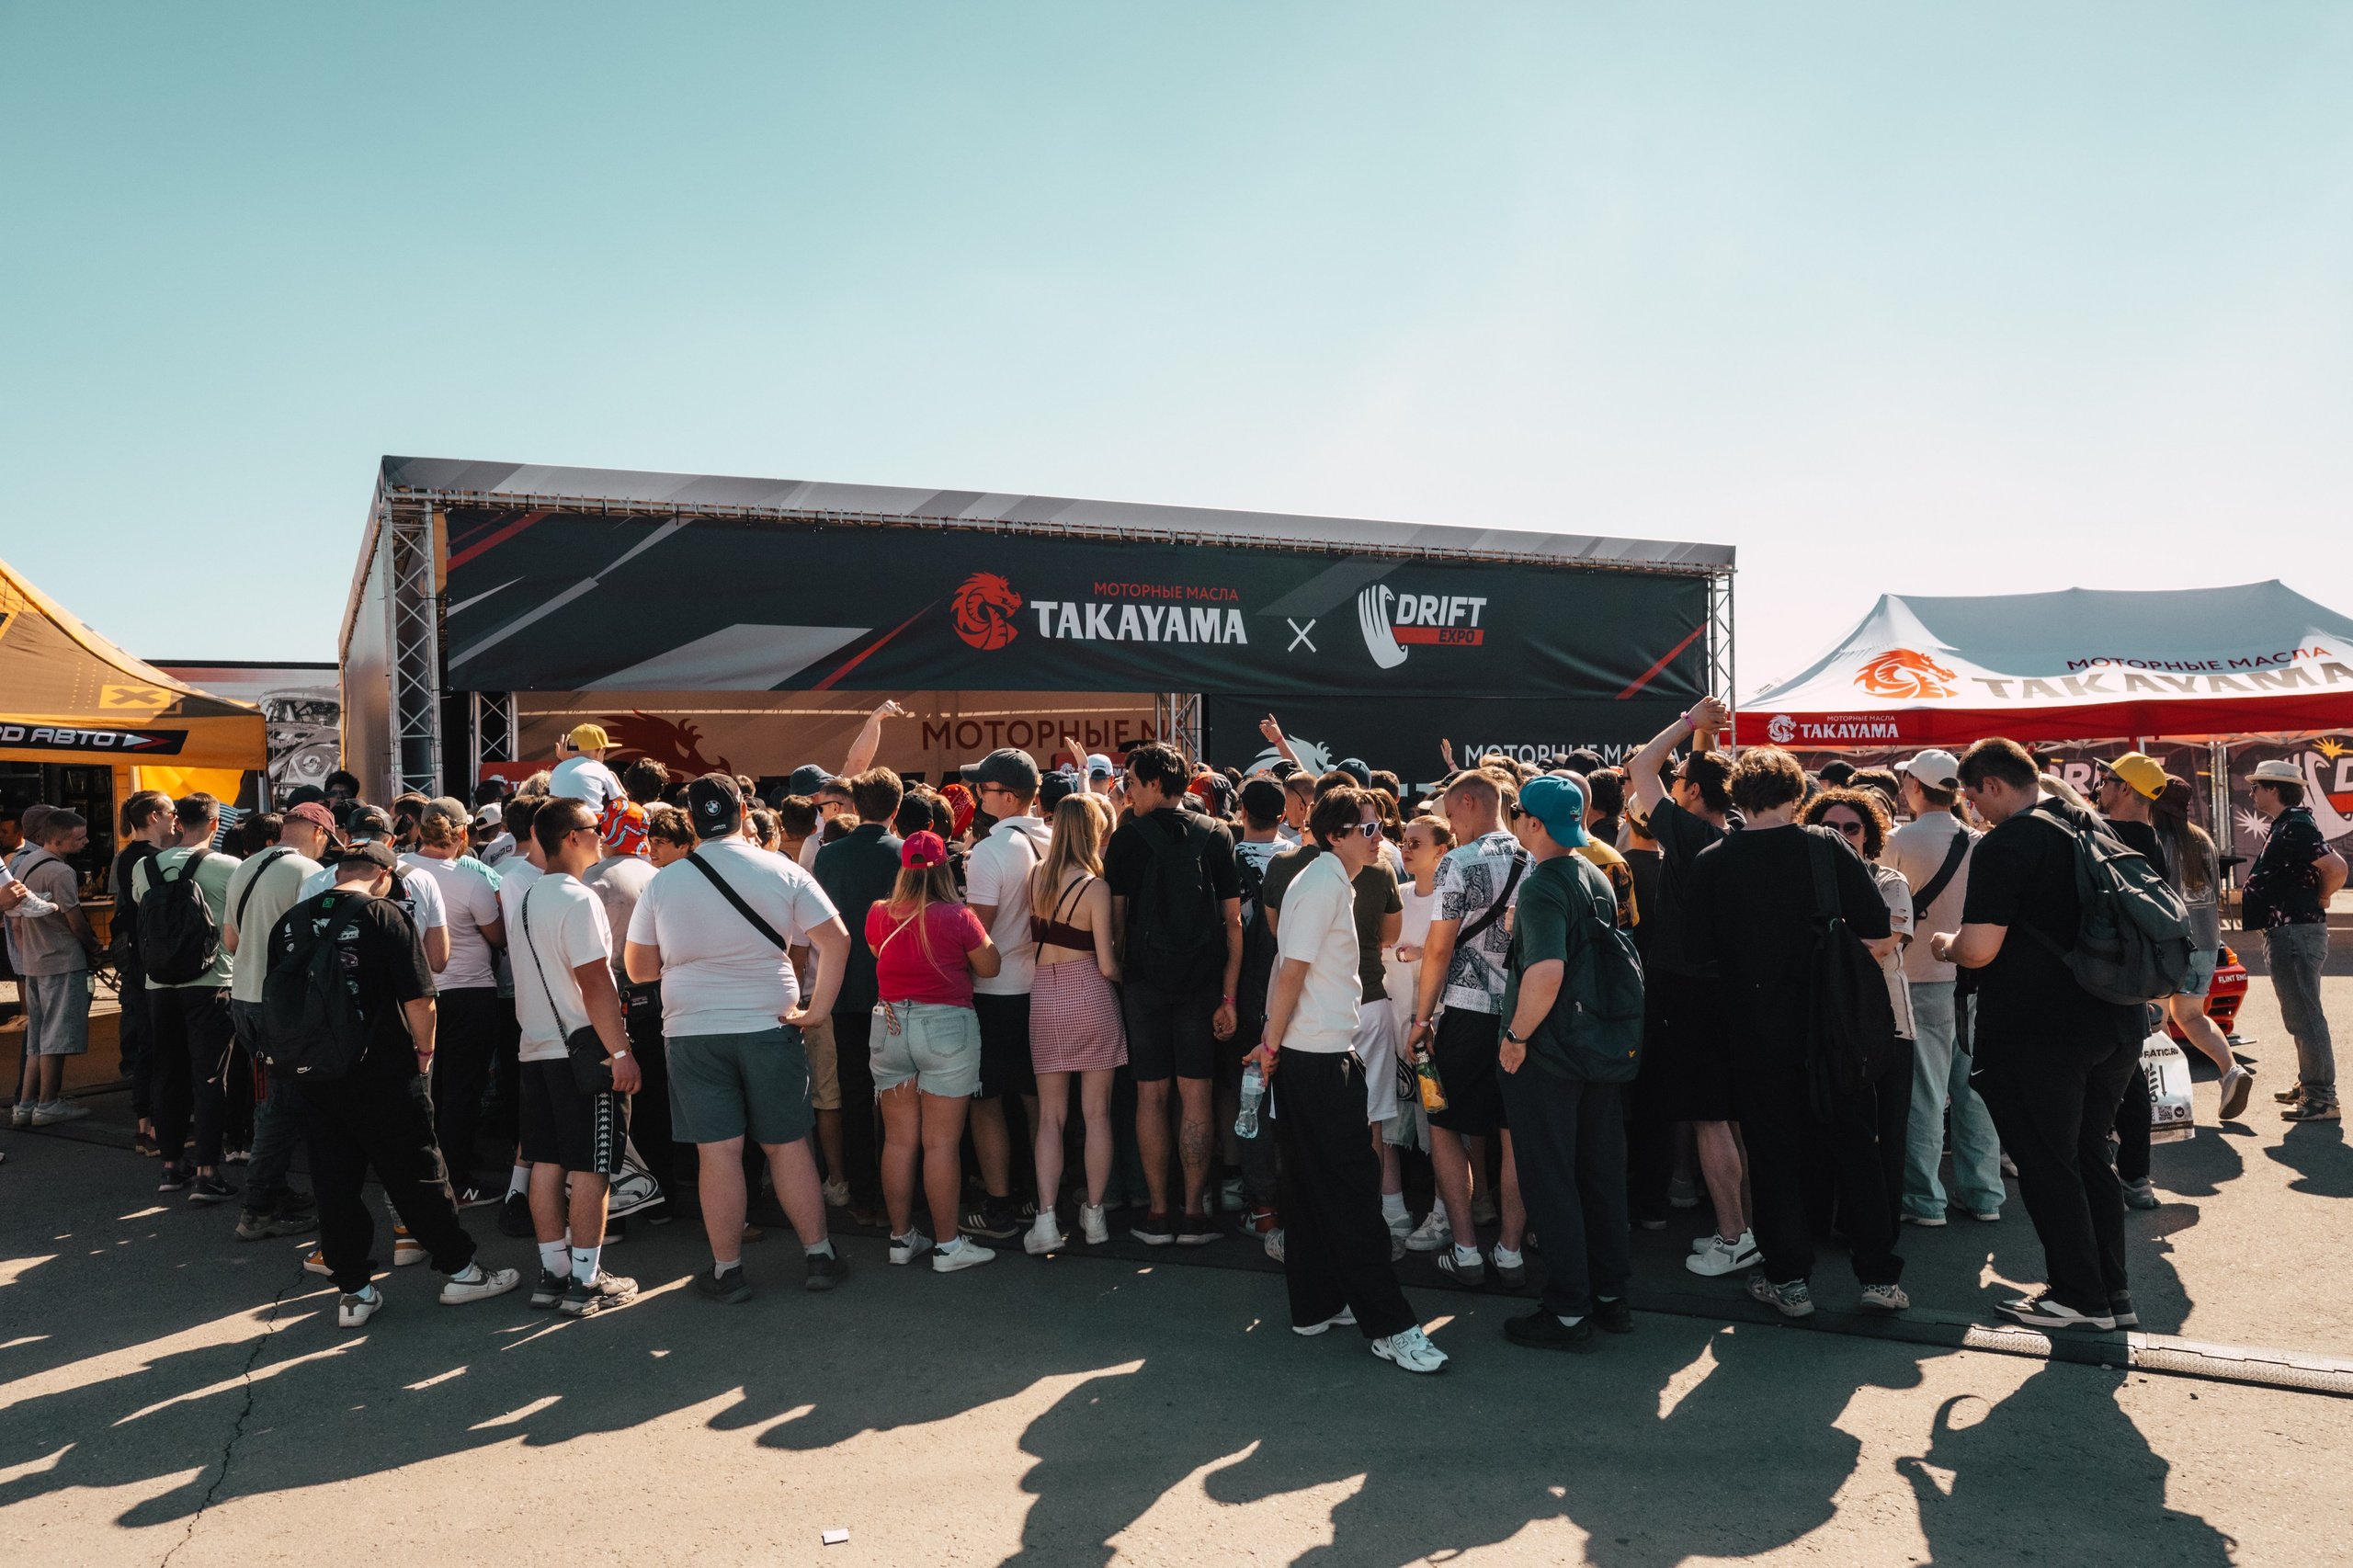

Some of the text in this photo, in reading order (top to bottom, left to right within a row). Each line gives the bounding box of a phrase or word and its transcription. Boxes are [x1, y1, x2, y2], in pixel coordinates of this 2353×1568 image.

[1094, 582, 1239, 602] МОТОРНЫЕ МАСЛА
[1030, 600, 1248, 644] TAKAYAMA
[1395, 594, 1487, 628] DRIFT
[1438, 629, 1475, 643] EXPO
[2066, 646, 2334, 672] МОТОРНЫЕ МАСЛА
[1971, 662, 2353, 699] TAKAYAMA
[29, 728, 117, 746] АВТО
[922, 720, 1130, 750] МОТОРНЫЕ
[1800, 723, 1899, 739] TAKAYAMA
[2218, 974, 2235, 983] FLINT
